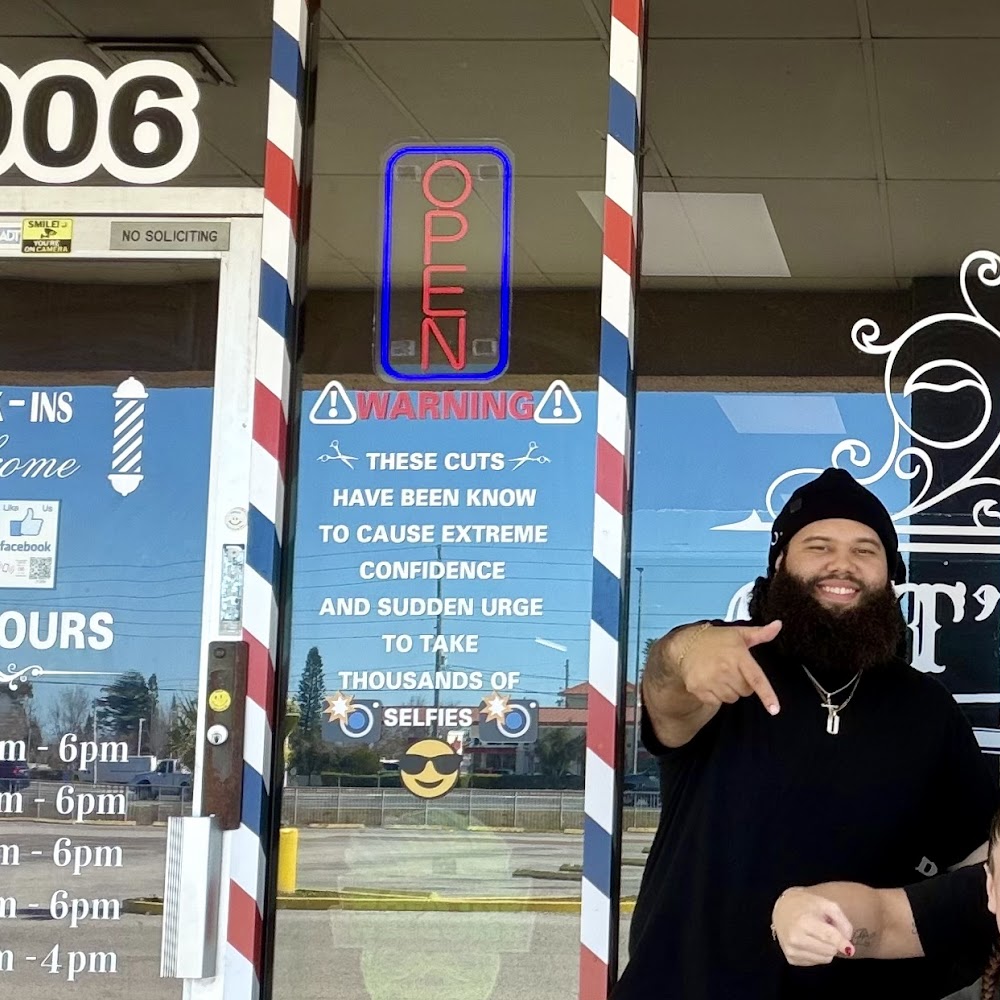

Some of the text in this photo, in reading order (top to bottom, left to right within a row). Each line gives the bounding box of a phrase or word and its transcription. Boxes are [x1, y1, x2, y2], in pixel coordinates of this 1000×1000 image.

[0, 64, 195, 178] 06
[122, 231, 218, 242] NO SOLICITING
[421, 159, 473, 371] OPEN
[356, 391, 534, 420] WARNING
[366, 452, 505, 470] THESE CUTS
[333, 488, 536, 507] HAVE BEEN KNOW
[3, 504, 53, 512] Like Us
[319, 525, 547, 543] TO CAUSE EXTREME
[0, 540, 51, 552] facebook
[359, 561, 505, 580] CONFIDENCE
[319, 598, 543, 616] AND SUDDEN URGE
[382, 635, 478, 653] TO TAKE
[338, 672, 520, 690] THOUSANDS OF
[384, 708, 472, 727] SELFIES
[59, 733, 129, 771] 6pm
[56, 785, 126, 823] 6pm
[53, 837, 123, 875] 6pm
[50, 890, 120, 928] 6pm
